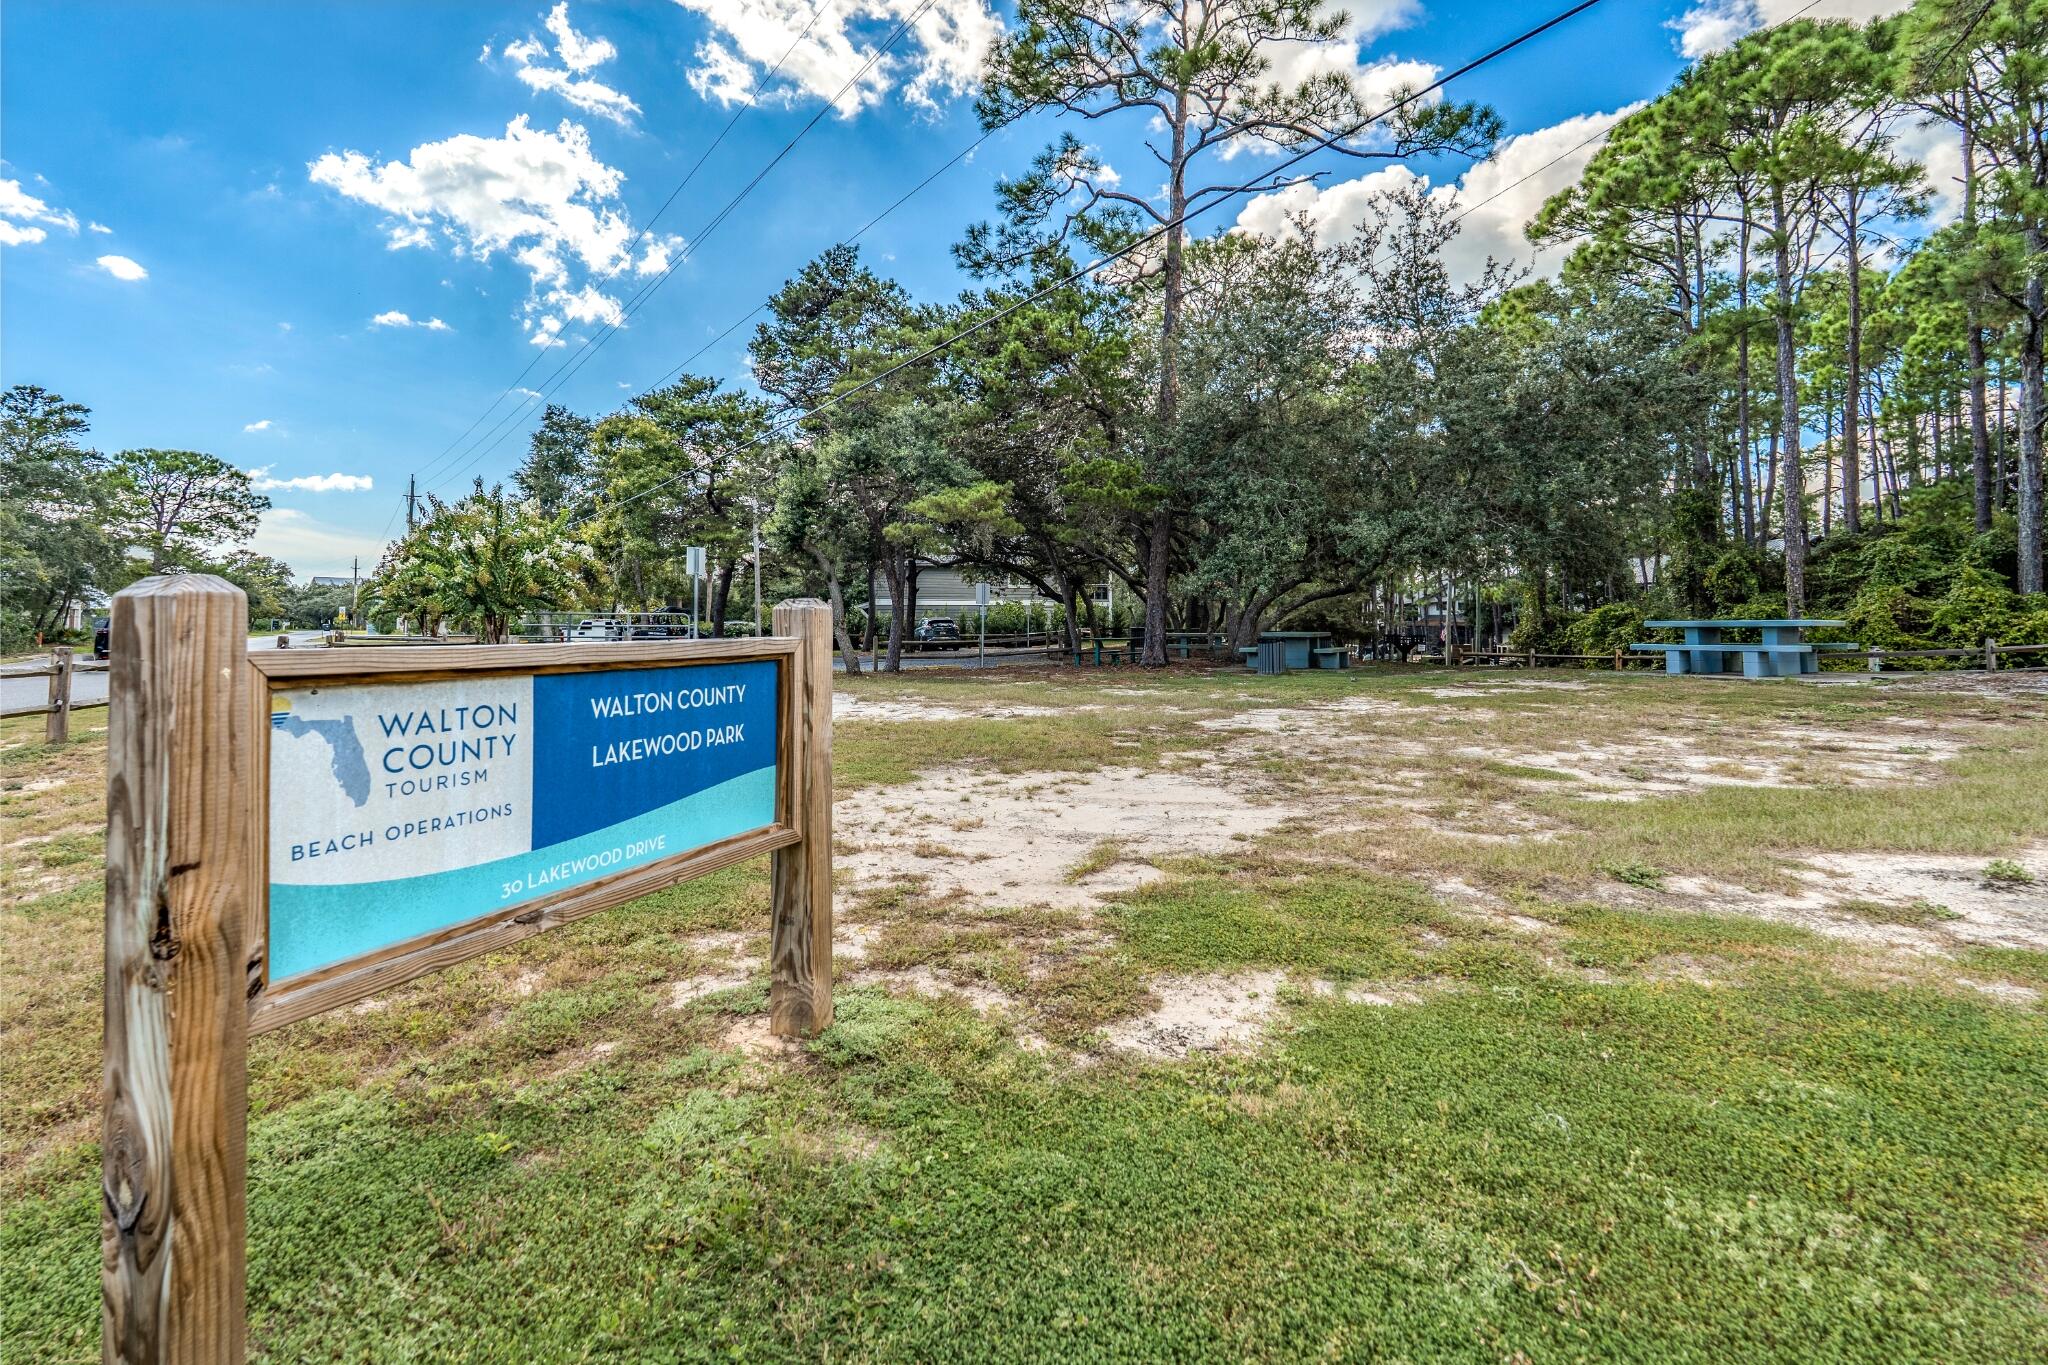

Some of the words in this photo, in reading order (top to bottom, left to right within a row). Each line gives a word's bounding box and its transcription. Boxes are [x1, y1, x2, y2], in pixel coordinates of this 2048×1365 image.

[379, 703, 517, 738] WALTON
[590, 692, 673, 719] WALTON
[677, 684, 747, 711] COUNTY
[383, 734, 516, 773] COUNTY
[592, 730, 702, 767] LAKEWOOD
[705, 723, 746, 748] PARK
[386, 769, 488, 798] TOURISM
[291, 831, 374, 861] BEACH
[385, 803, 513, 841] OPERATIONS
[500, 879, 524, 900] 30
[528, 849, 623, 889] LAKEWOOD
[625, 833, 667, 860] DRIVE
